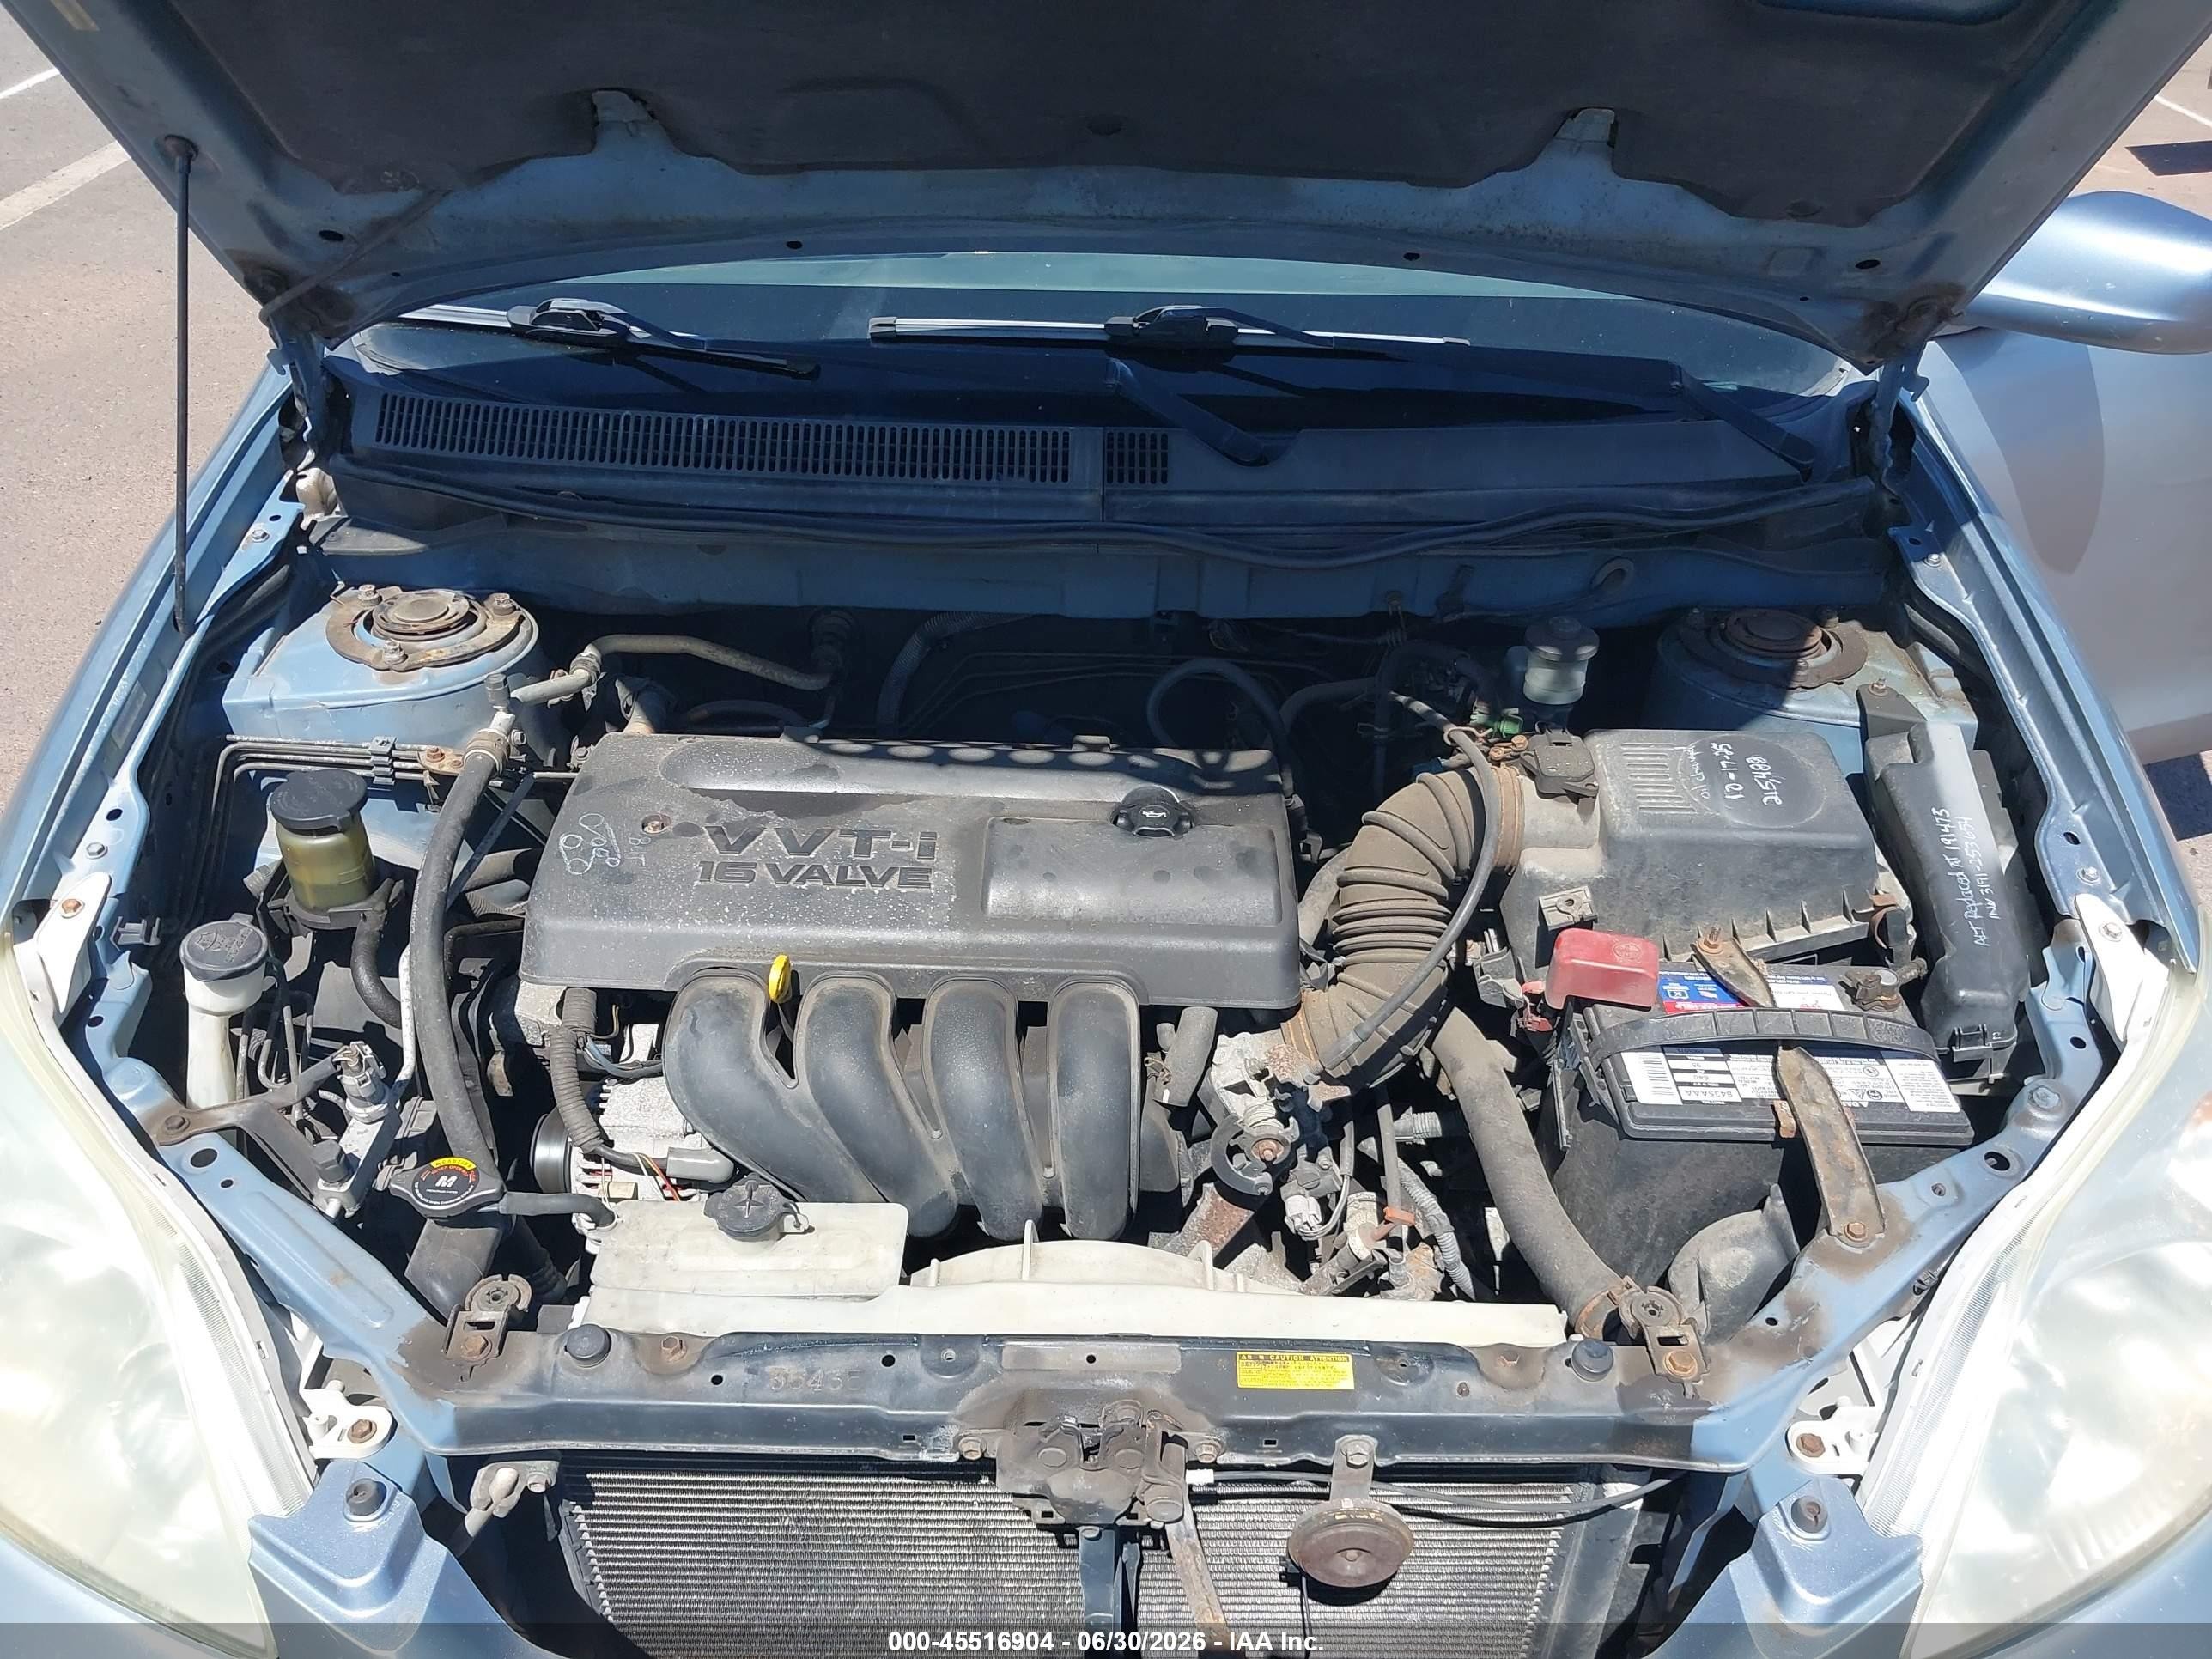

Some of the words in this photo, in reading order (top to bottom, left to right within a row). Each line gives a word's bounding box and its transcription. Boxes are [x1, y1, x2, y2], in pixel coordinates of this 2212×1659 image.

[697, 860, 757, 884] 16
[772, 862, 933, 890] VALVE
[1968, 921, 1990, 946] ALT
